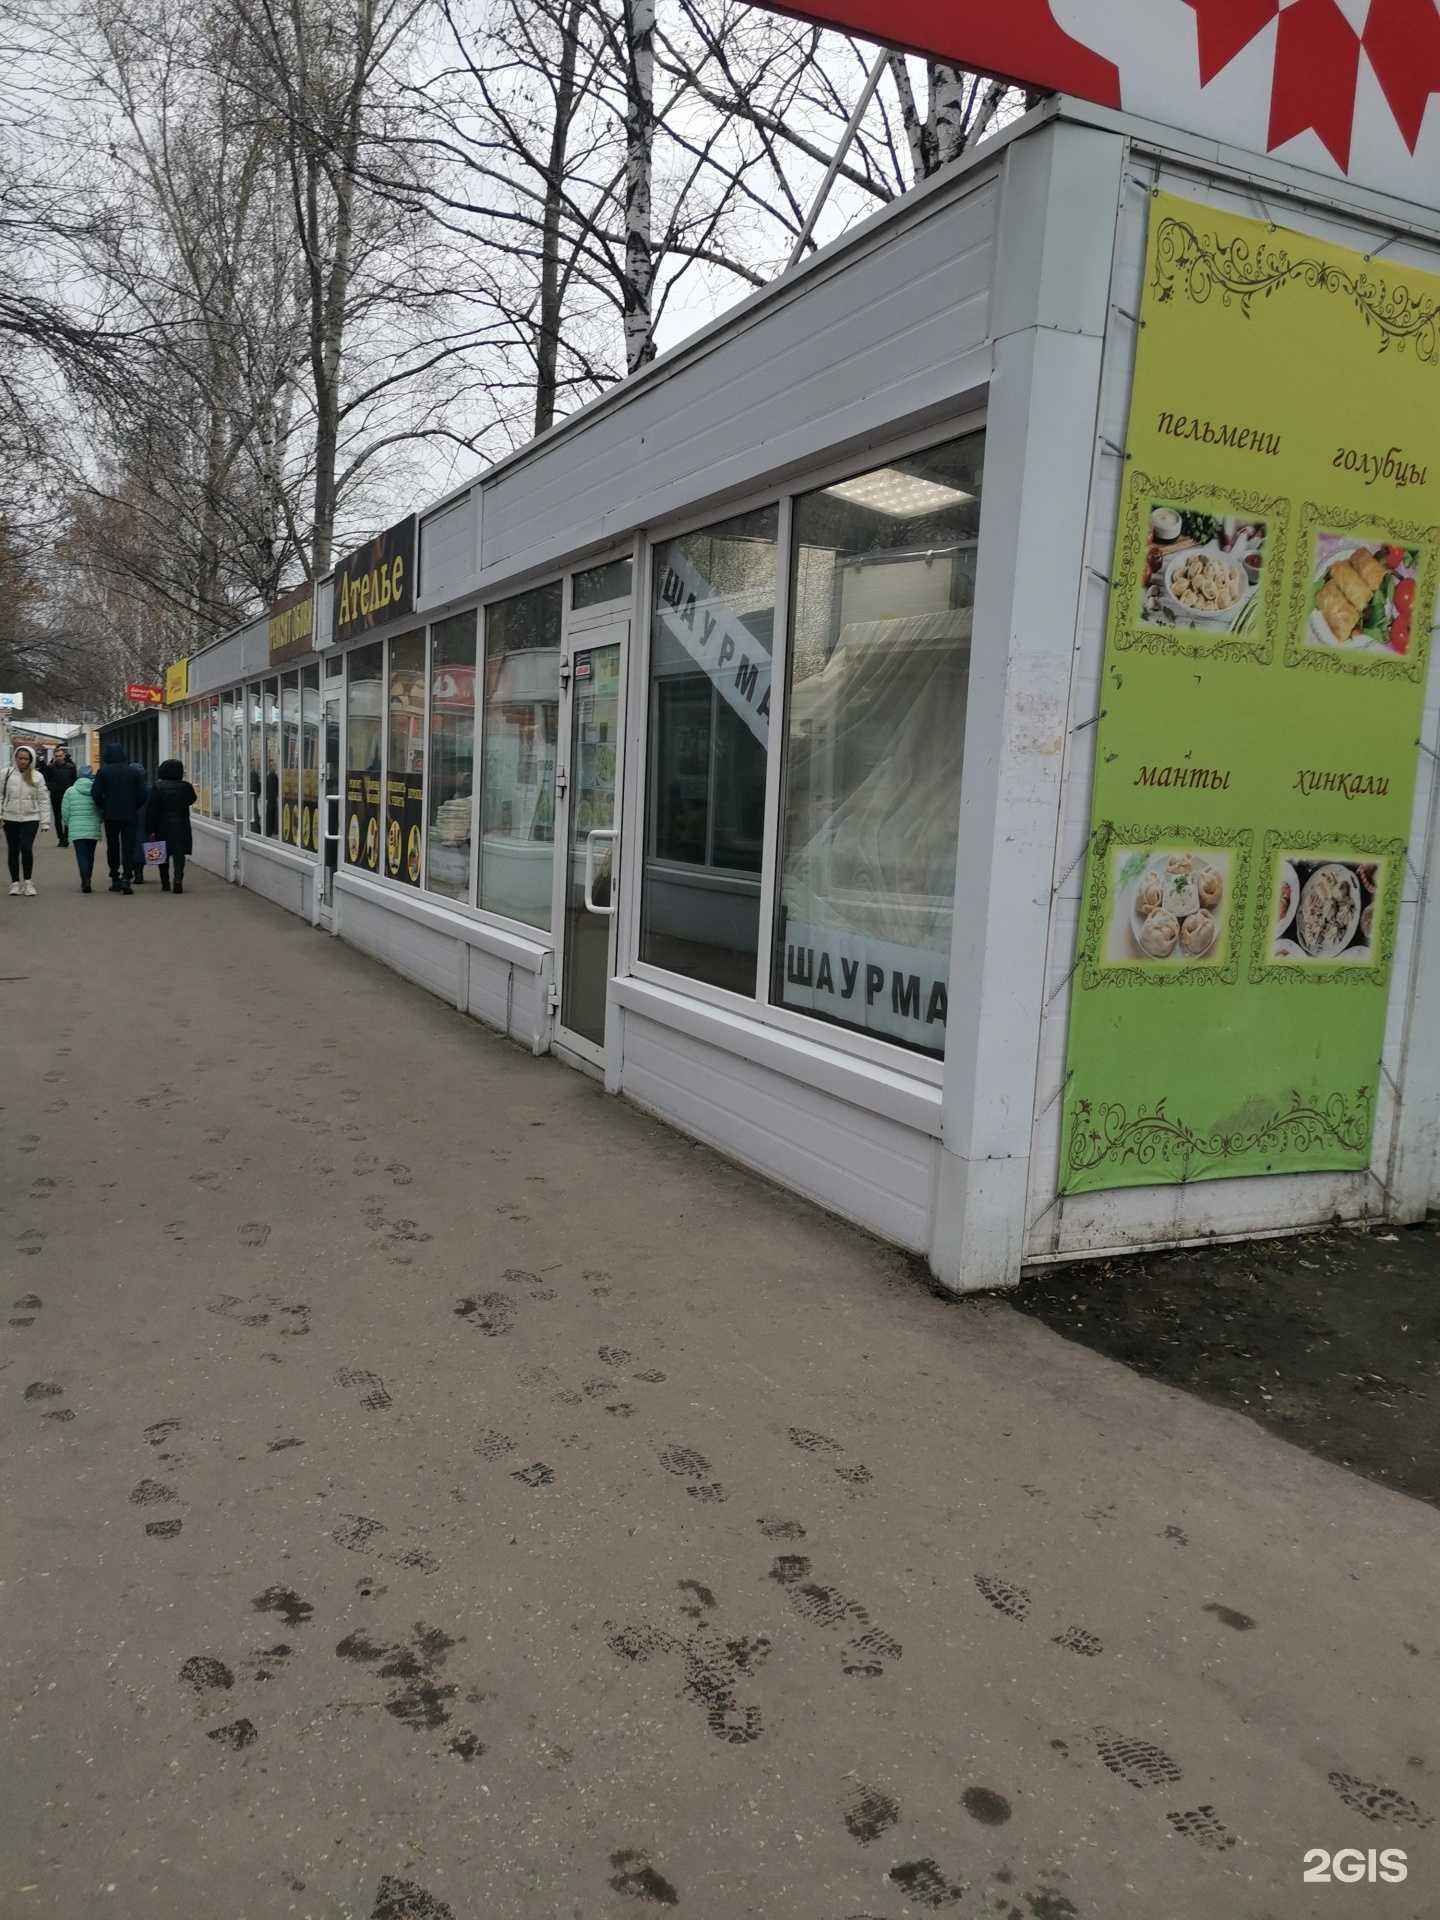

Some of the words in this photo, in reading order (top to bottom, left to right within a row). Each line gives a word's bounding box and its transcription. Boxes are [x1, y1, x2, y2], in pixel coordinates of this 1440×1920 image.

[1157, 410, 1281, 456] пельмени
[1332, 446, 1428, 487] голубцы
[338, 555, 404, 626] Ателье
[1133, 765, 1231, 790] манты
[1292, 768, 1392, 800] хинкали
[787, 944, 949, 1029] ШАУРМА
